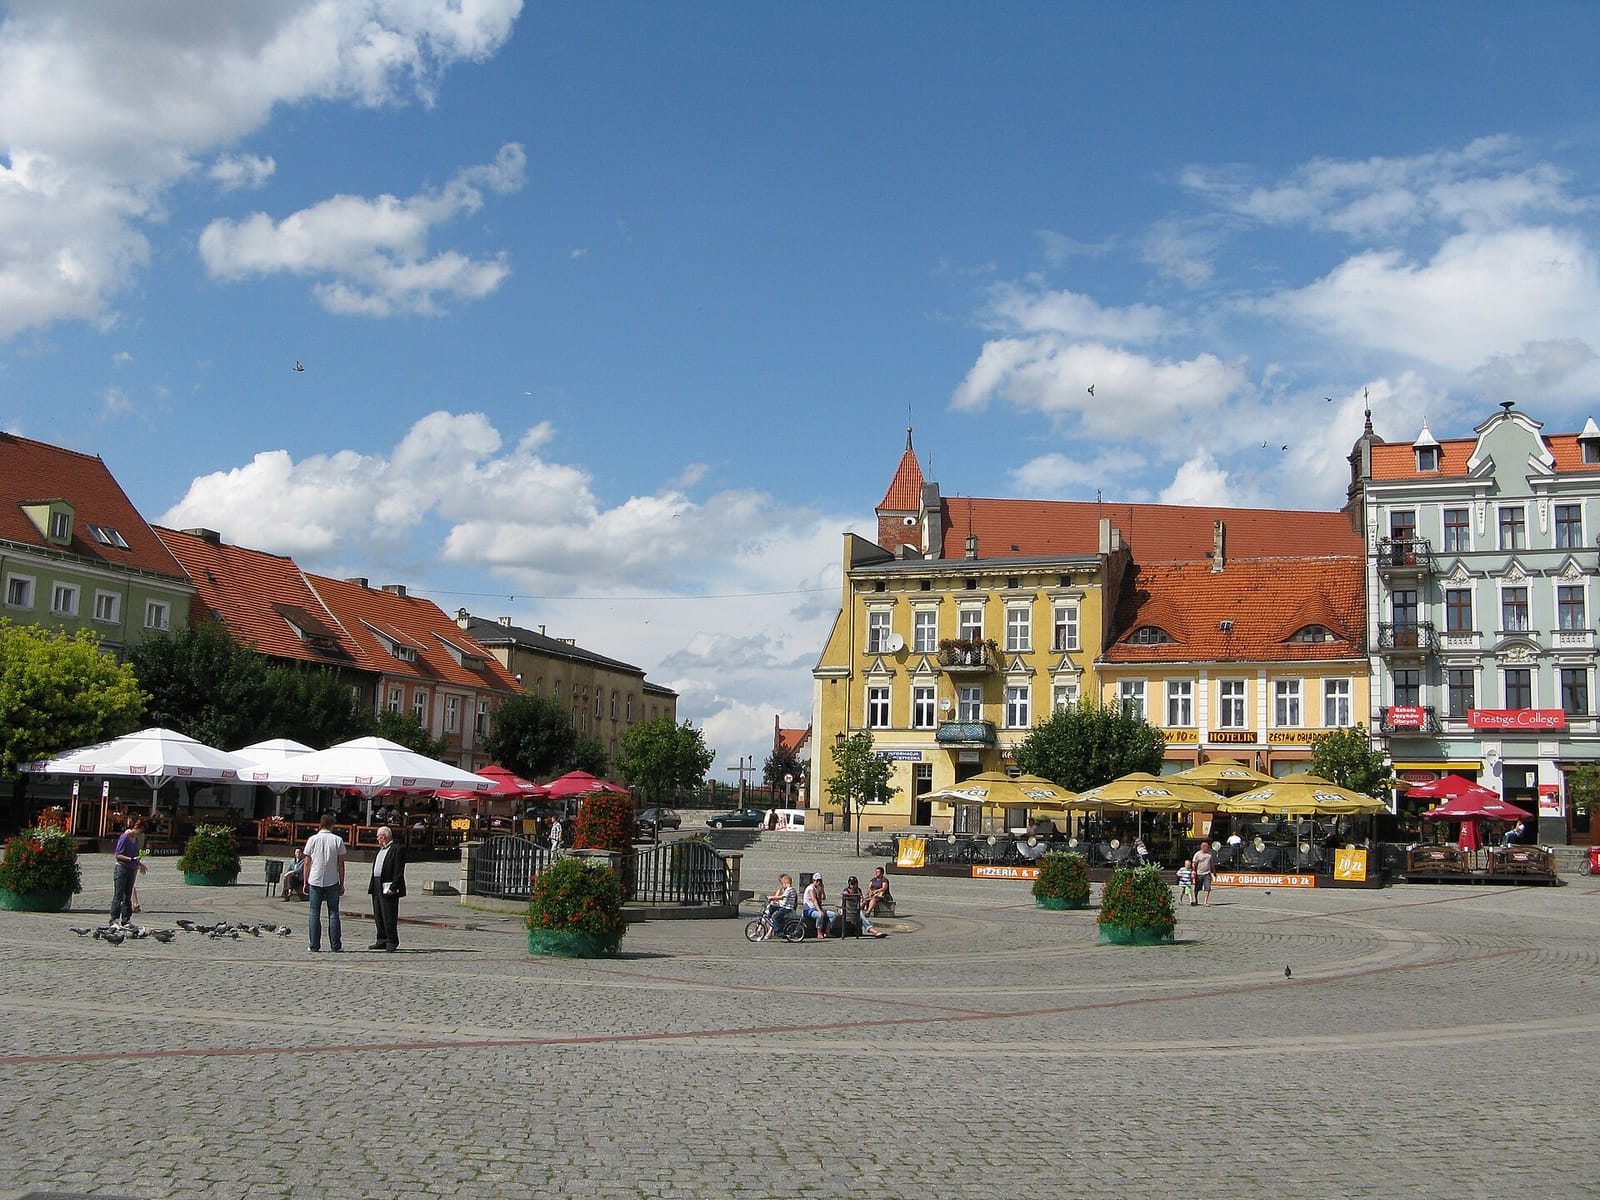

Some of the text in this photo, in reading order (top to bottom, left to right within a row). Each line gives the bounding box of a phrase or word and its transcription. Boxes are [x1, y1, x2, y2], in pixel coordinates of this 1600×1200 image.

[1473, 711, 1559, 727] Prestige College
[1209, 732, 1255, 742] HOTELIK
[1268, 733, 1295, 742] ZESTAW
[1339, 858, 1351, 870] 10
[976, 867, 1018, 877] PIZZERIA
[1238, 875, 1283, 885] OBIADOWE
[1287, 876, 1298, 885] 10
